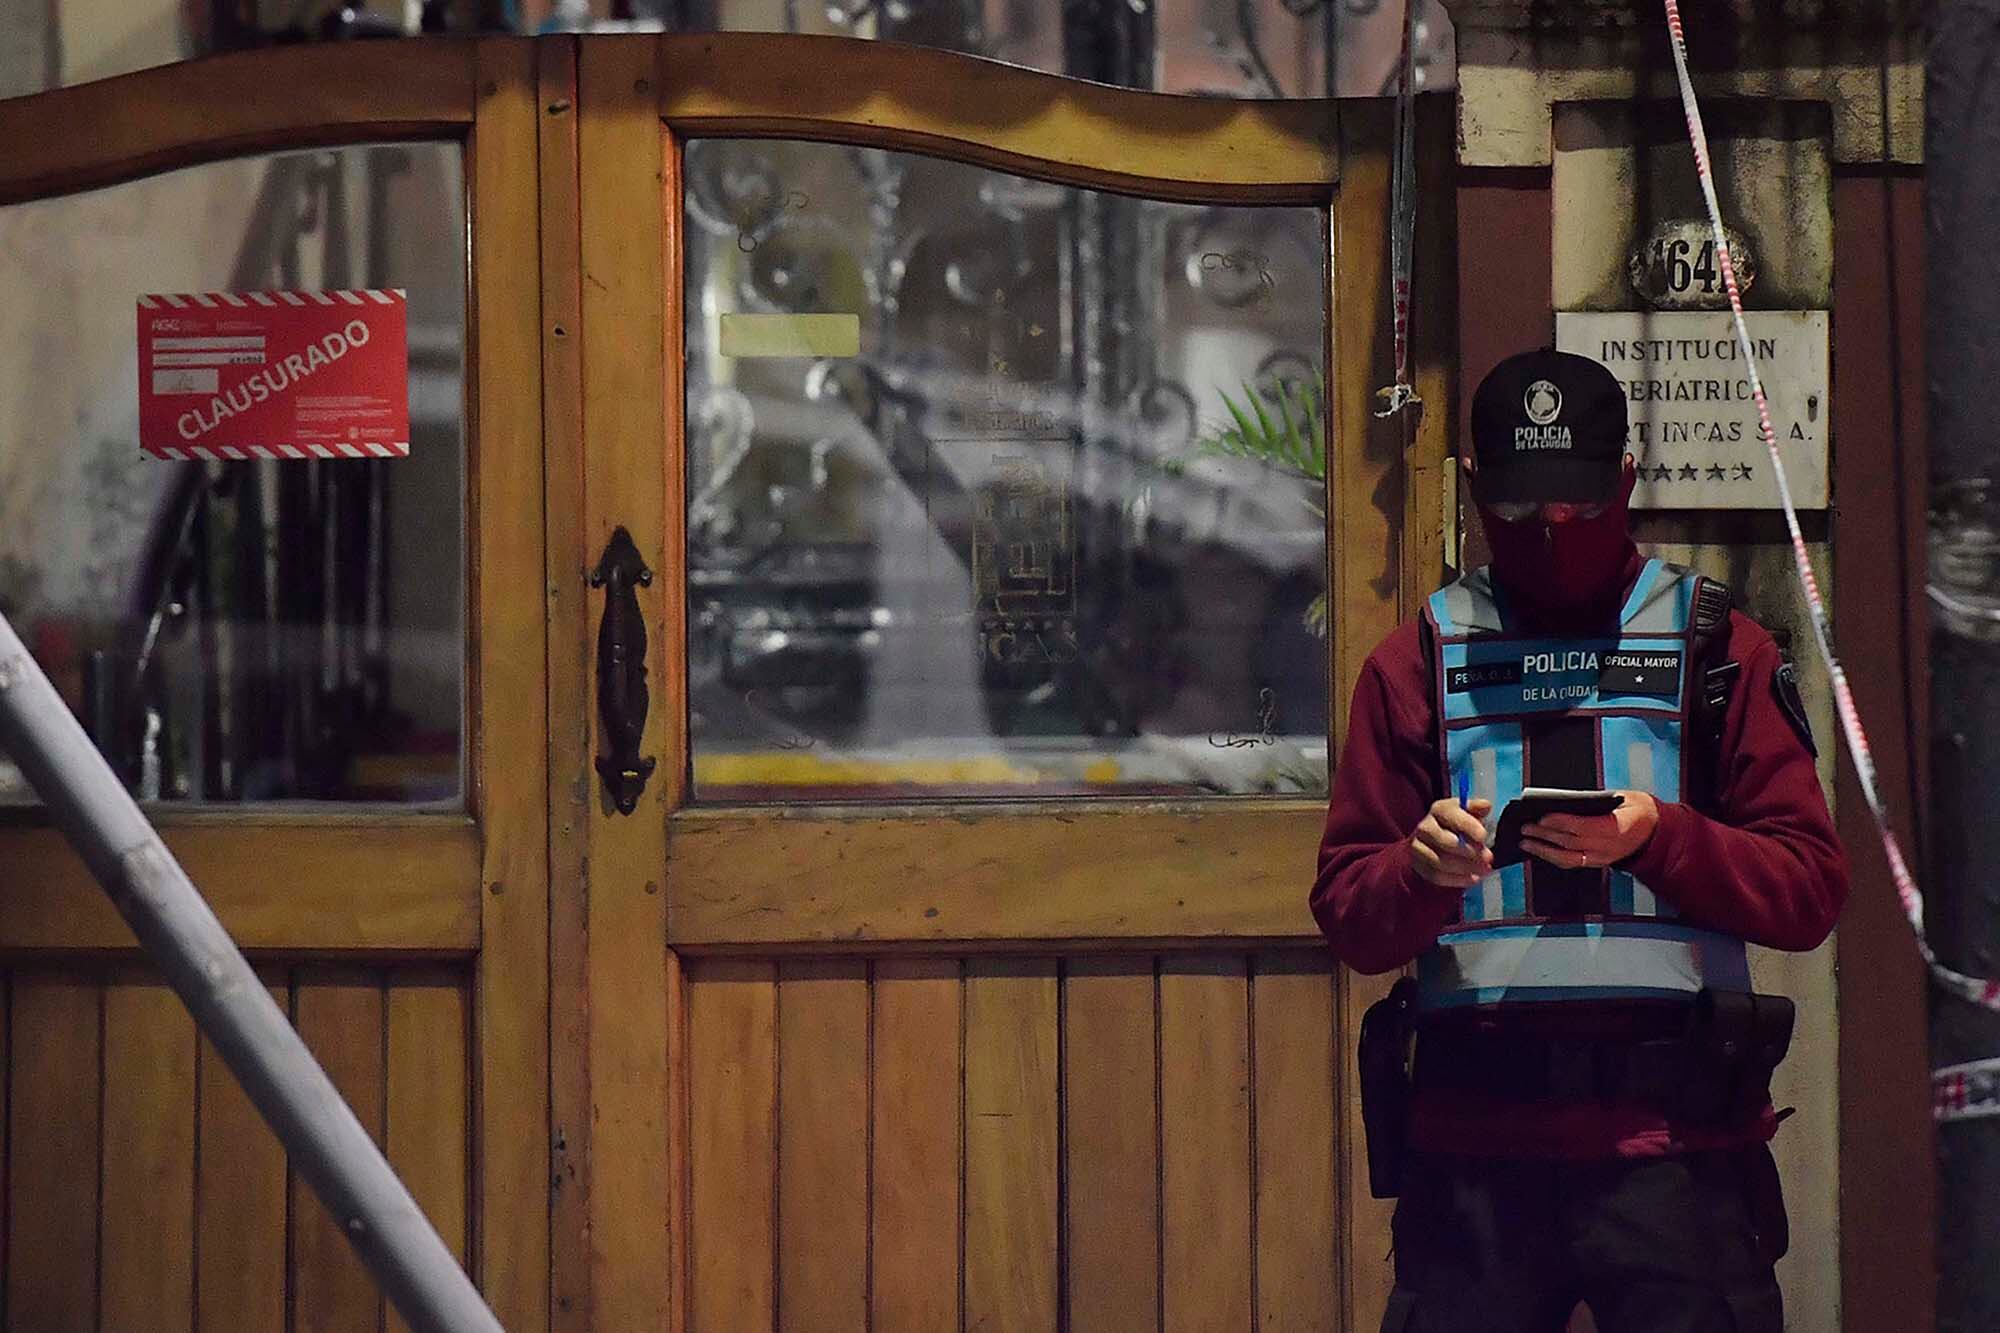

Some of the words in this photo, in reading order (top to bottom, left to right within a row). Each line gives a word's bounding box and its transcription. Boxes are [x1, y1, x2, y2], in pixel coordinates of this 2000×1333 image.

[177, 320, 369, 440] CLAUSURADO
[1618, 380, 1768, 401] ERIATRICA
[1515, 426, 1571, 440] POLICIA
[1663, 421, 1742, 442] INCAS
[1523, 651, 1599, 674] POLICIA
[1605, 656, 1642, 668] OFICIAL
[1644, 656, 1678, 668] MAYOR
[1523, 688, 1539, 701] DE
[1541, 687, 1557, 700] LA
